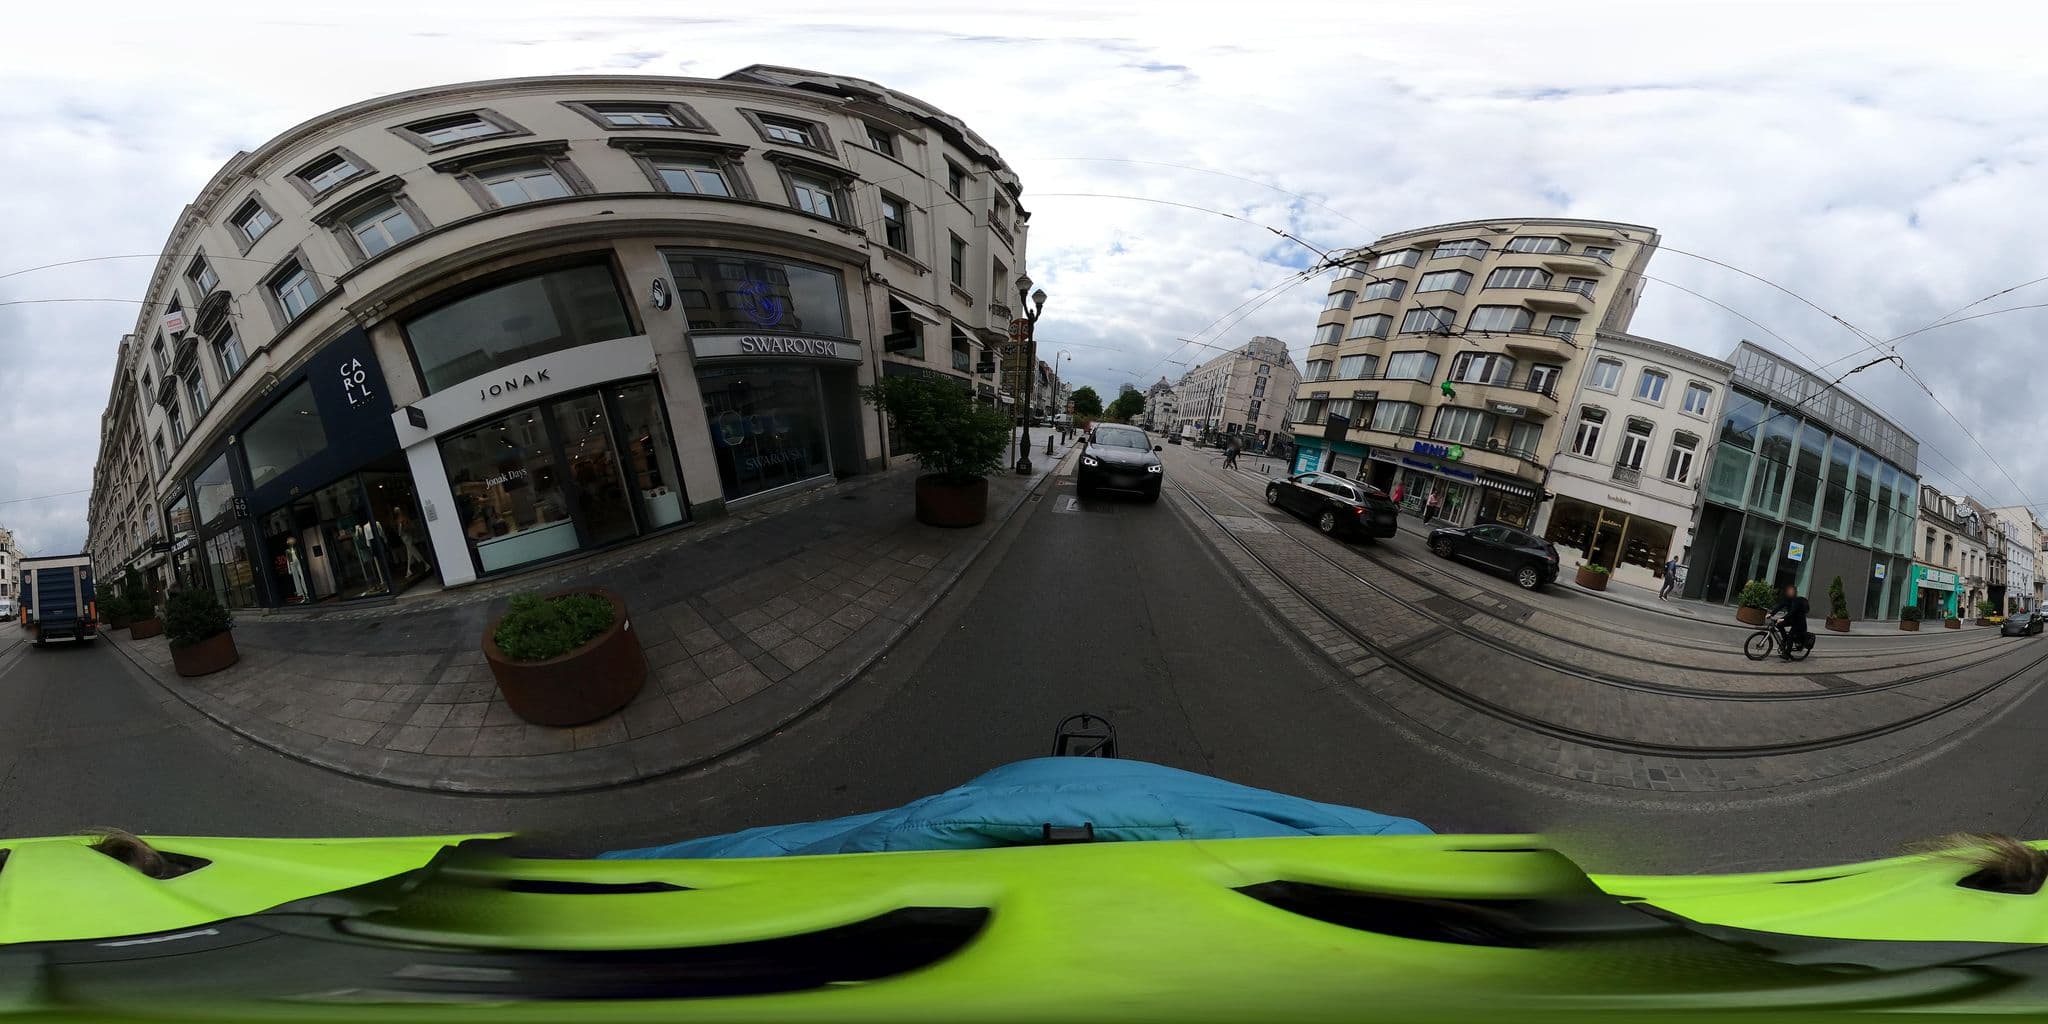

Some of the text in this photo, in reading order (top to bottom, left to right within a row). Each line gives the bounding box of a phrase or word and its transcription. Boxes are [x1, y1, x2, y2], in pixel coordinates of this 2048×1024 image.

[741, 335, 838, 356] SWAROVSKI
[480, 368, 550, 400] JONAK
[485, 468, 528, 490] Jonak Days
